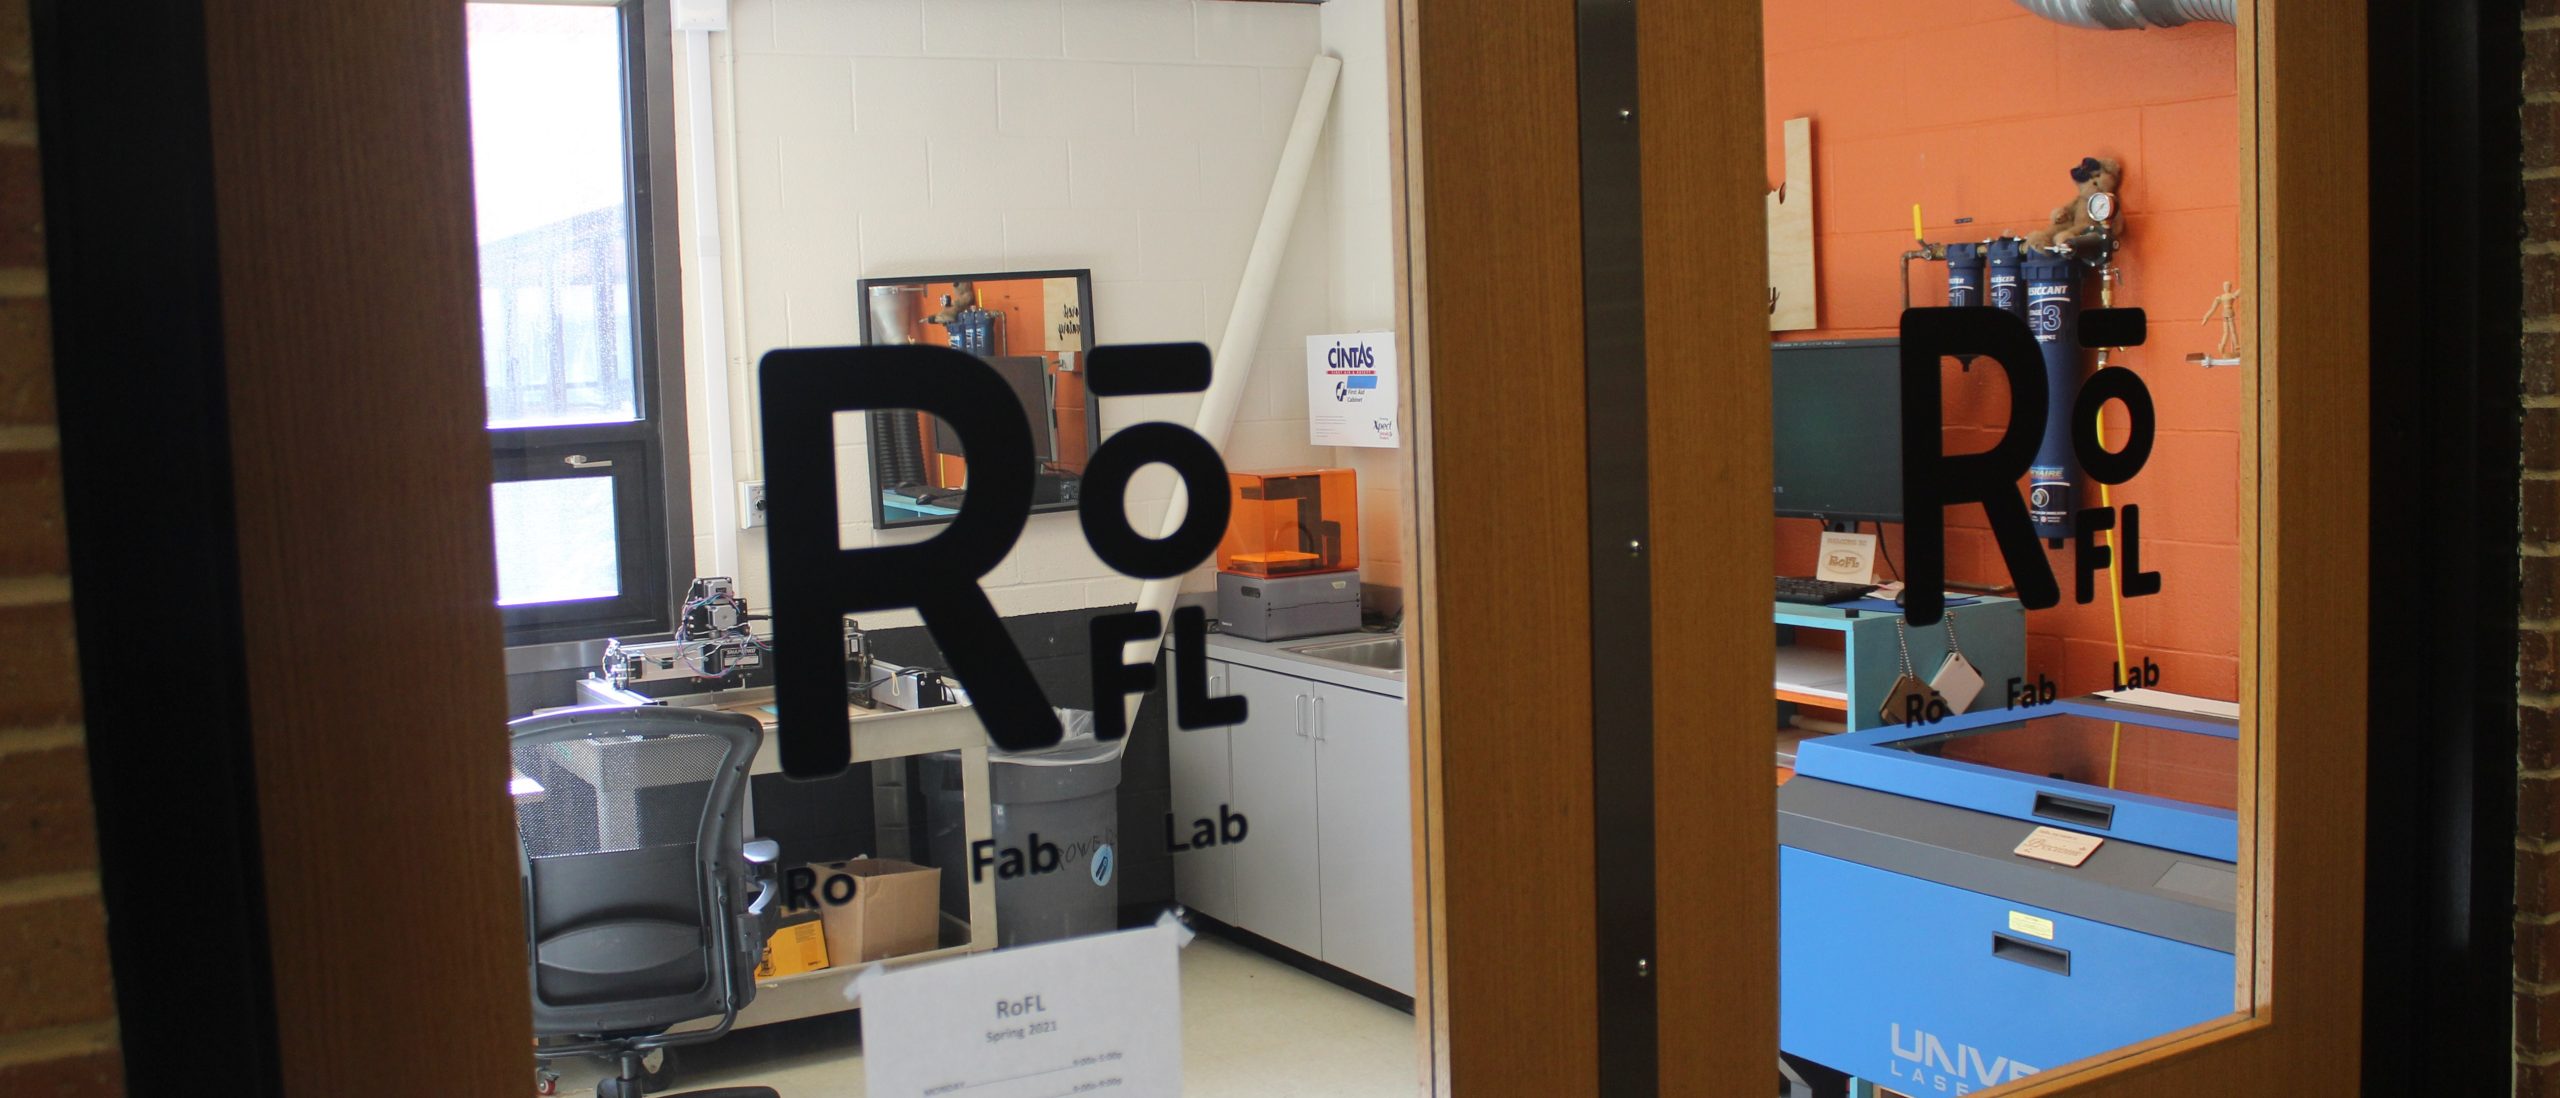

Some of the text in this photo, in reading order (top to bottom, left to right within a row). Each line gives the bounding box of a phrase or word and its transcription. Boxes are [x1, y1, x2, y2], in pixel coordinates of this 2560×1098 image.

[1999, 288, 2012, 306] 2
[2043, 304, 2062, 331] 3
[1327, 340, 1375, 369] CINTAS
[1828, 555, 1860, 568] RoFL
[2075, 504, 2161, 604] FL
[726, 648, 756, 656] SHAPKO
[1090, 605, 1248, 742] FL
[2007, 674, 2056, 711] Fab
[2113, 657, 2160, 692] Lab
[972, 833, 1060, 883] Fab
[1165, 805, 1248, 854] Lab
[996, 994, 1046, 1019] RoFL
[986, 1021, 1057, 1043] Spring 2021
